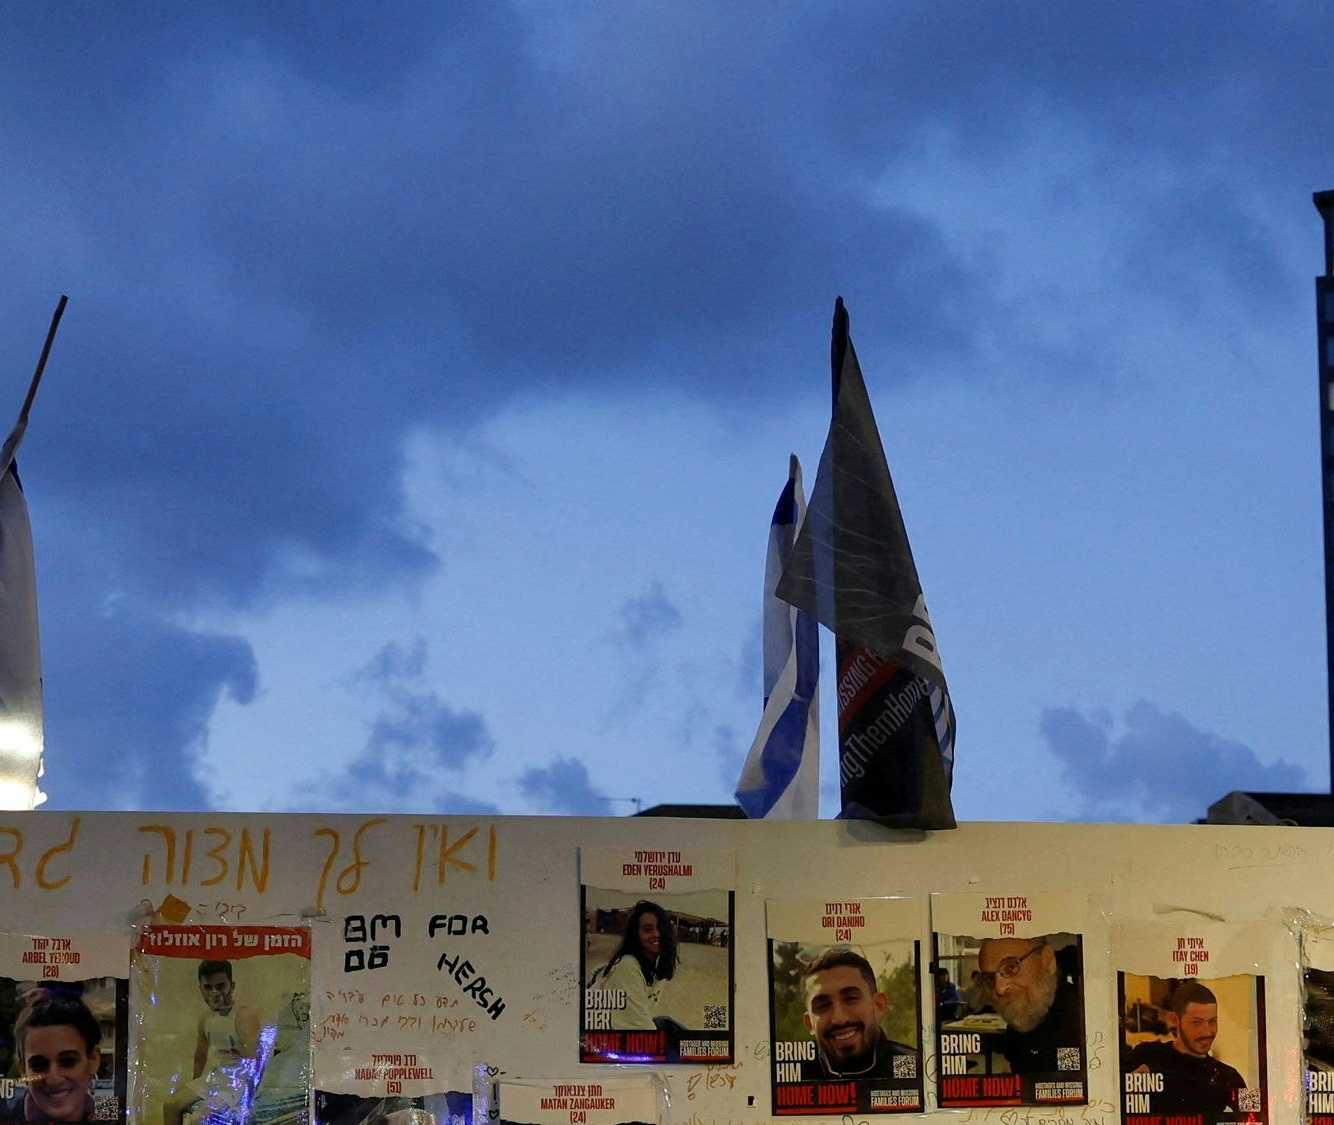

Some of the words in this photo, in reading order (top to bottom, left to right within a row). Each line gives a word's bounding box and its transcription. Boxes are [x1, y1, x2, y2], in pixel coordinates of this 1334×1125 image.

[137, 827, 271, 892] מצוה
[315, 820, 388, 905] לך
[414, 824, 497, 890] ואין
[623, 864, 641, 875] EDEN
[644, 865, 692, 876] YERUSHALMI
[650, 878, 665, 890] (24)
[822, 917, 835, 928] ORI
[837, 916, 865, 927] DANINO
[982, 911, 1000, 921] ALEX
[1001, 910, 1031, 921] DANCYG
[429, 915, 489, 938] FOR
[1000, 923, 1015, 935] (75)
[205, 934, 227, 951] רון
[234, 930, 258, 948] של
[265, 935, 302, 951] הזמן
[836, 929, 851, 941] (24)
[1173, 949, 1187, 961] ITAY
[1190, 951, 1209, 962] CHEN
[1185, 963, 1198, 975] (19)
[437, 953, 505, 1020] HERSH
[776, 1041, 815, 1061] BRING
[776, 1063, 801, 1083] HIM
[776, 1085, 814, 1105] HOME
[818, 1082, 856, 1105] NOW!
[541, 1098, 567, 1109] MATAN
[570, 1098, 614, 1109] ZANGAUKER
[570, 1111, 586, 1124] (24)
